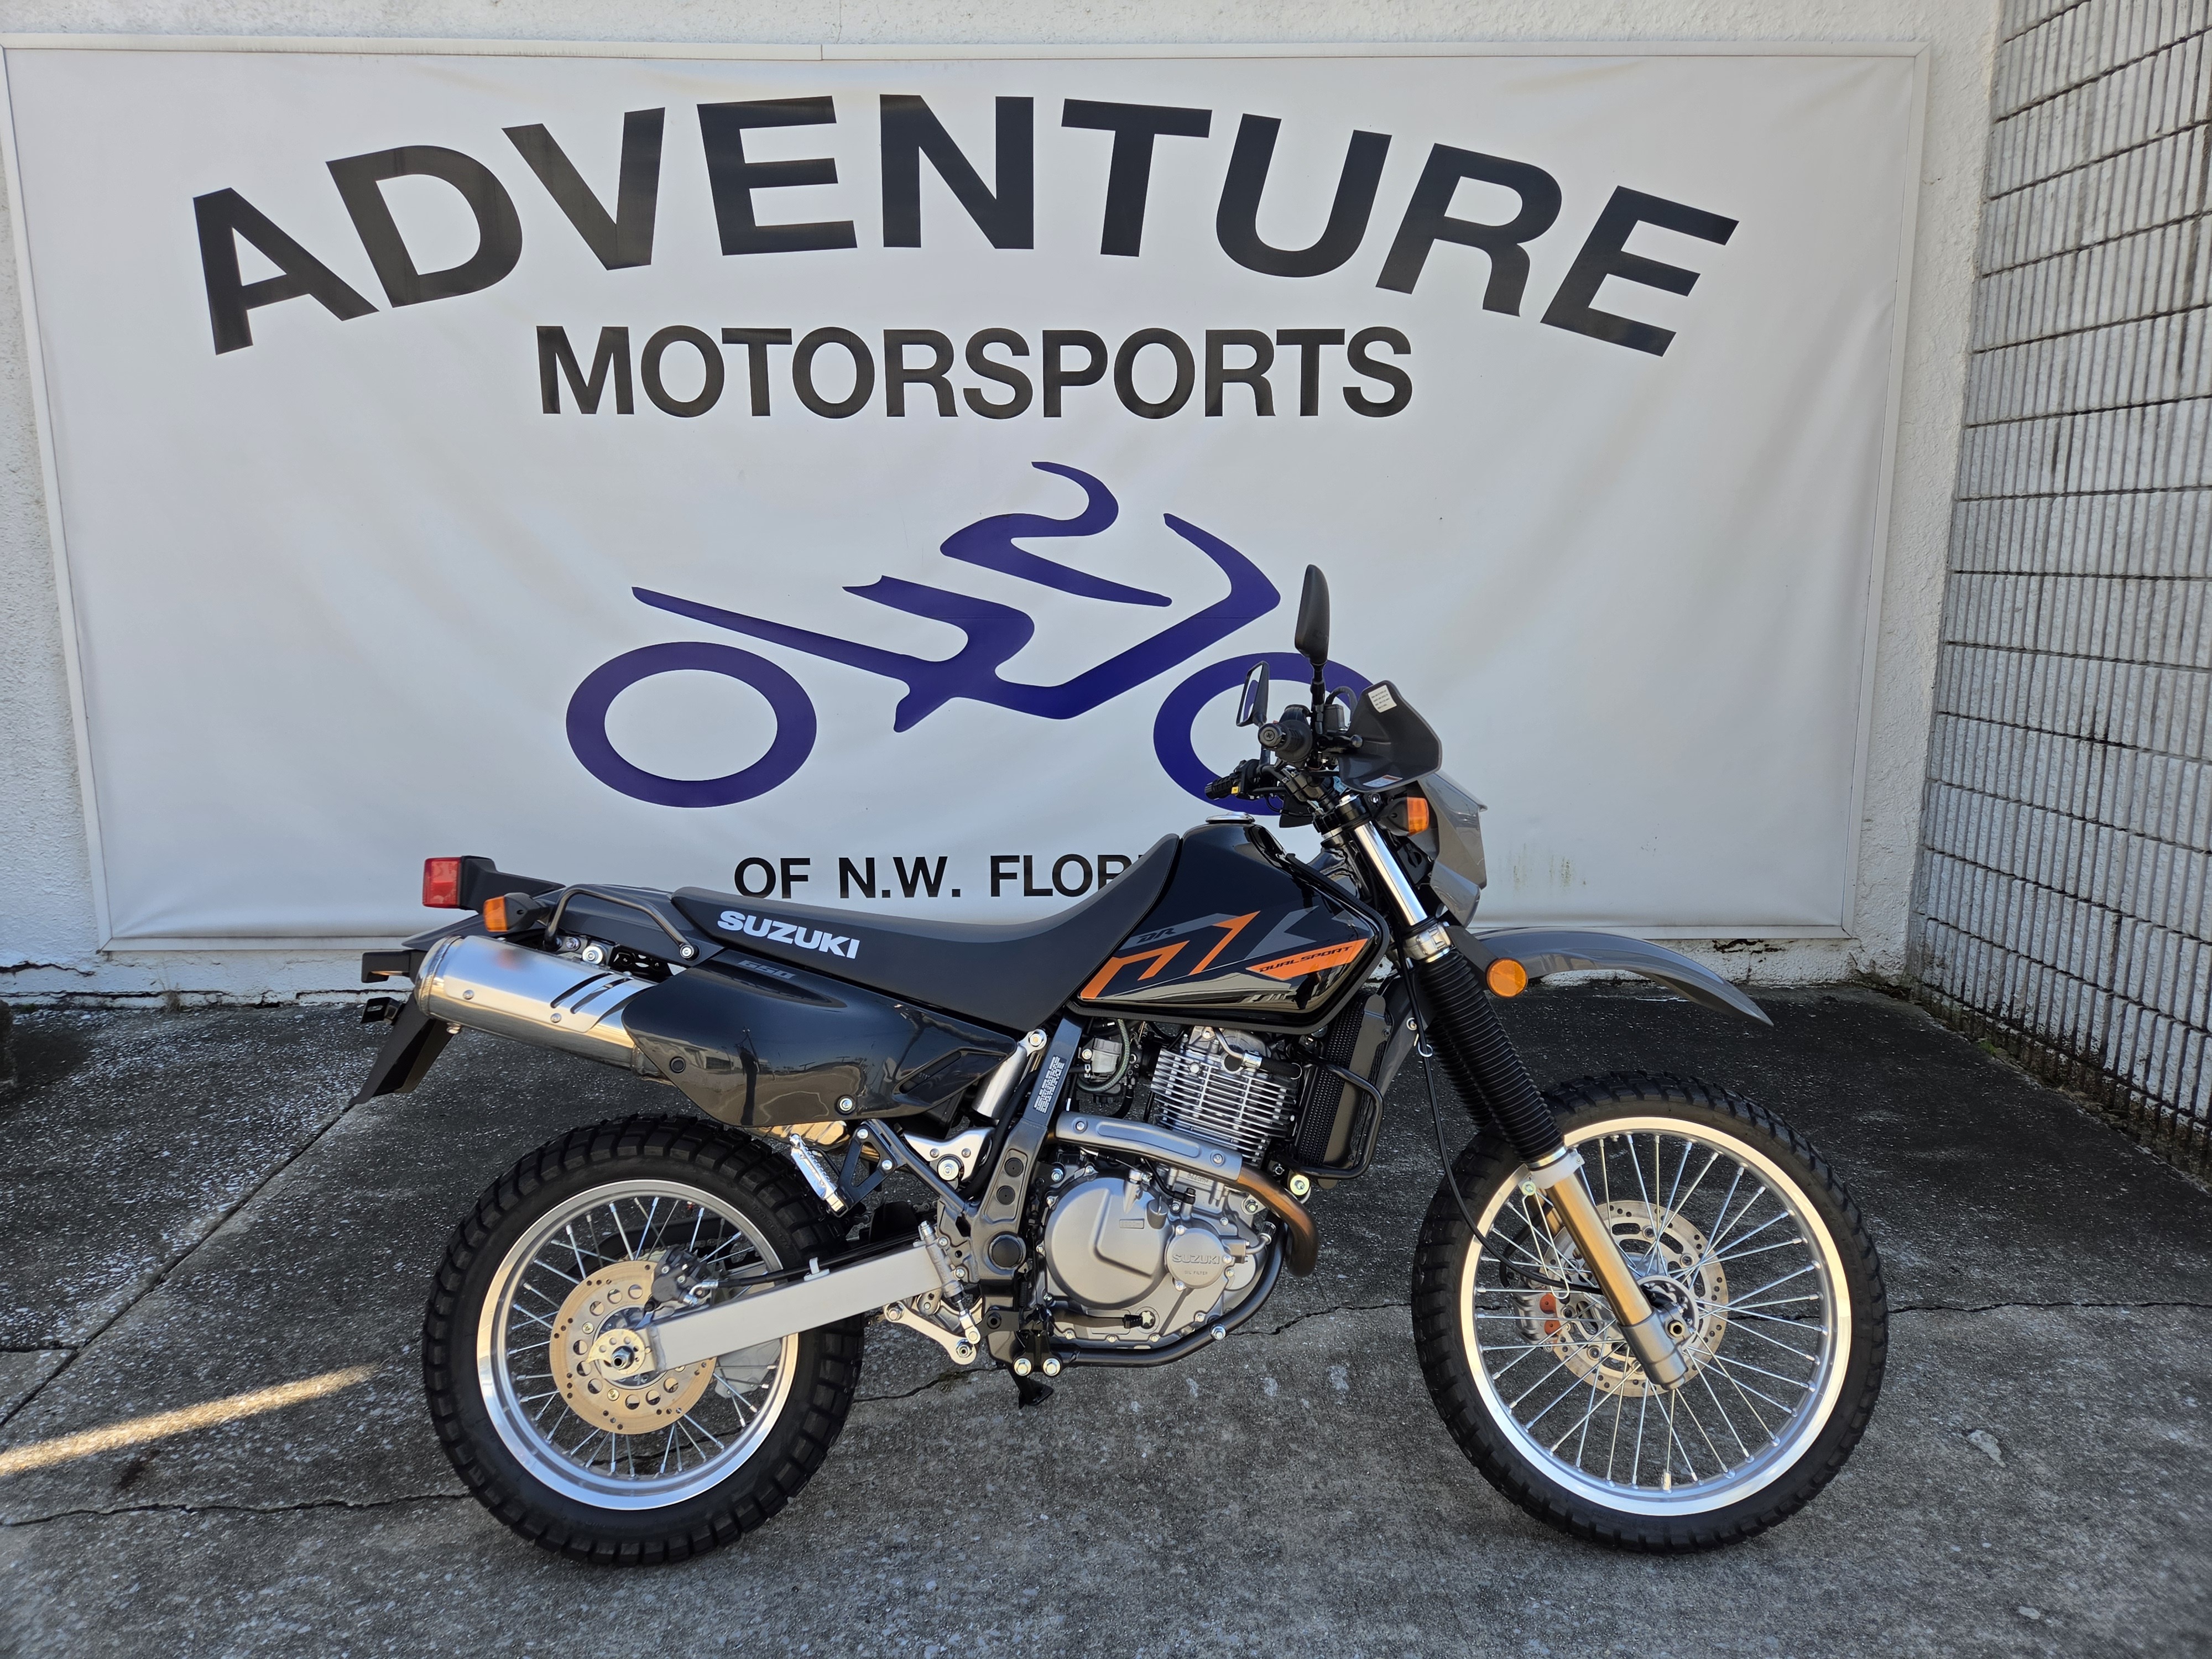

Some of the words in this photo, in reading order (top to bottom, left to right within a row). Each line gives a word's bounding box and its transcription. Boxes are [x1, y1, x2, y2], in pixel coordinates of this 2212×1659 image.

[194, 94, 1740, 357] ADVENTURE
[536, 325, 1412, 420] MOTORSPORTS
[734, 857, 811, 899] OF
[838, 856, 961, 899] N.W.
[990, 853, 1147, 897] FLOR
[717, 910, 860, 959] SUZUKI
[1136, 927, 1177, 945] DR
[737, 959, 796, 979] 650
[1172, 1253, 1220, 1265] SUZUKI
